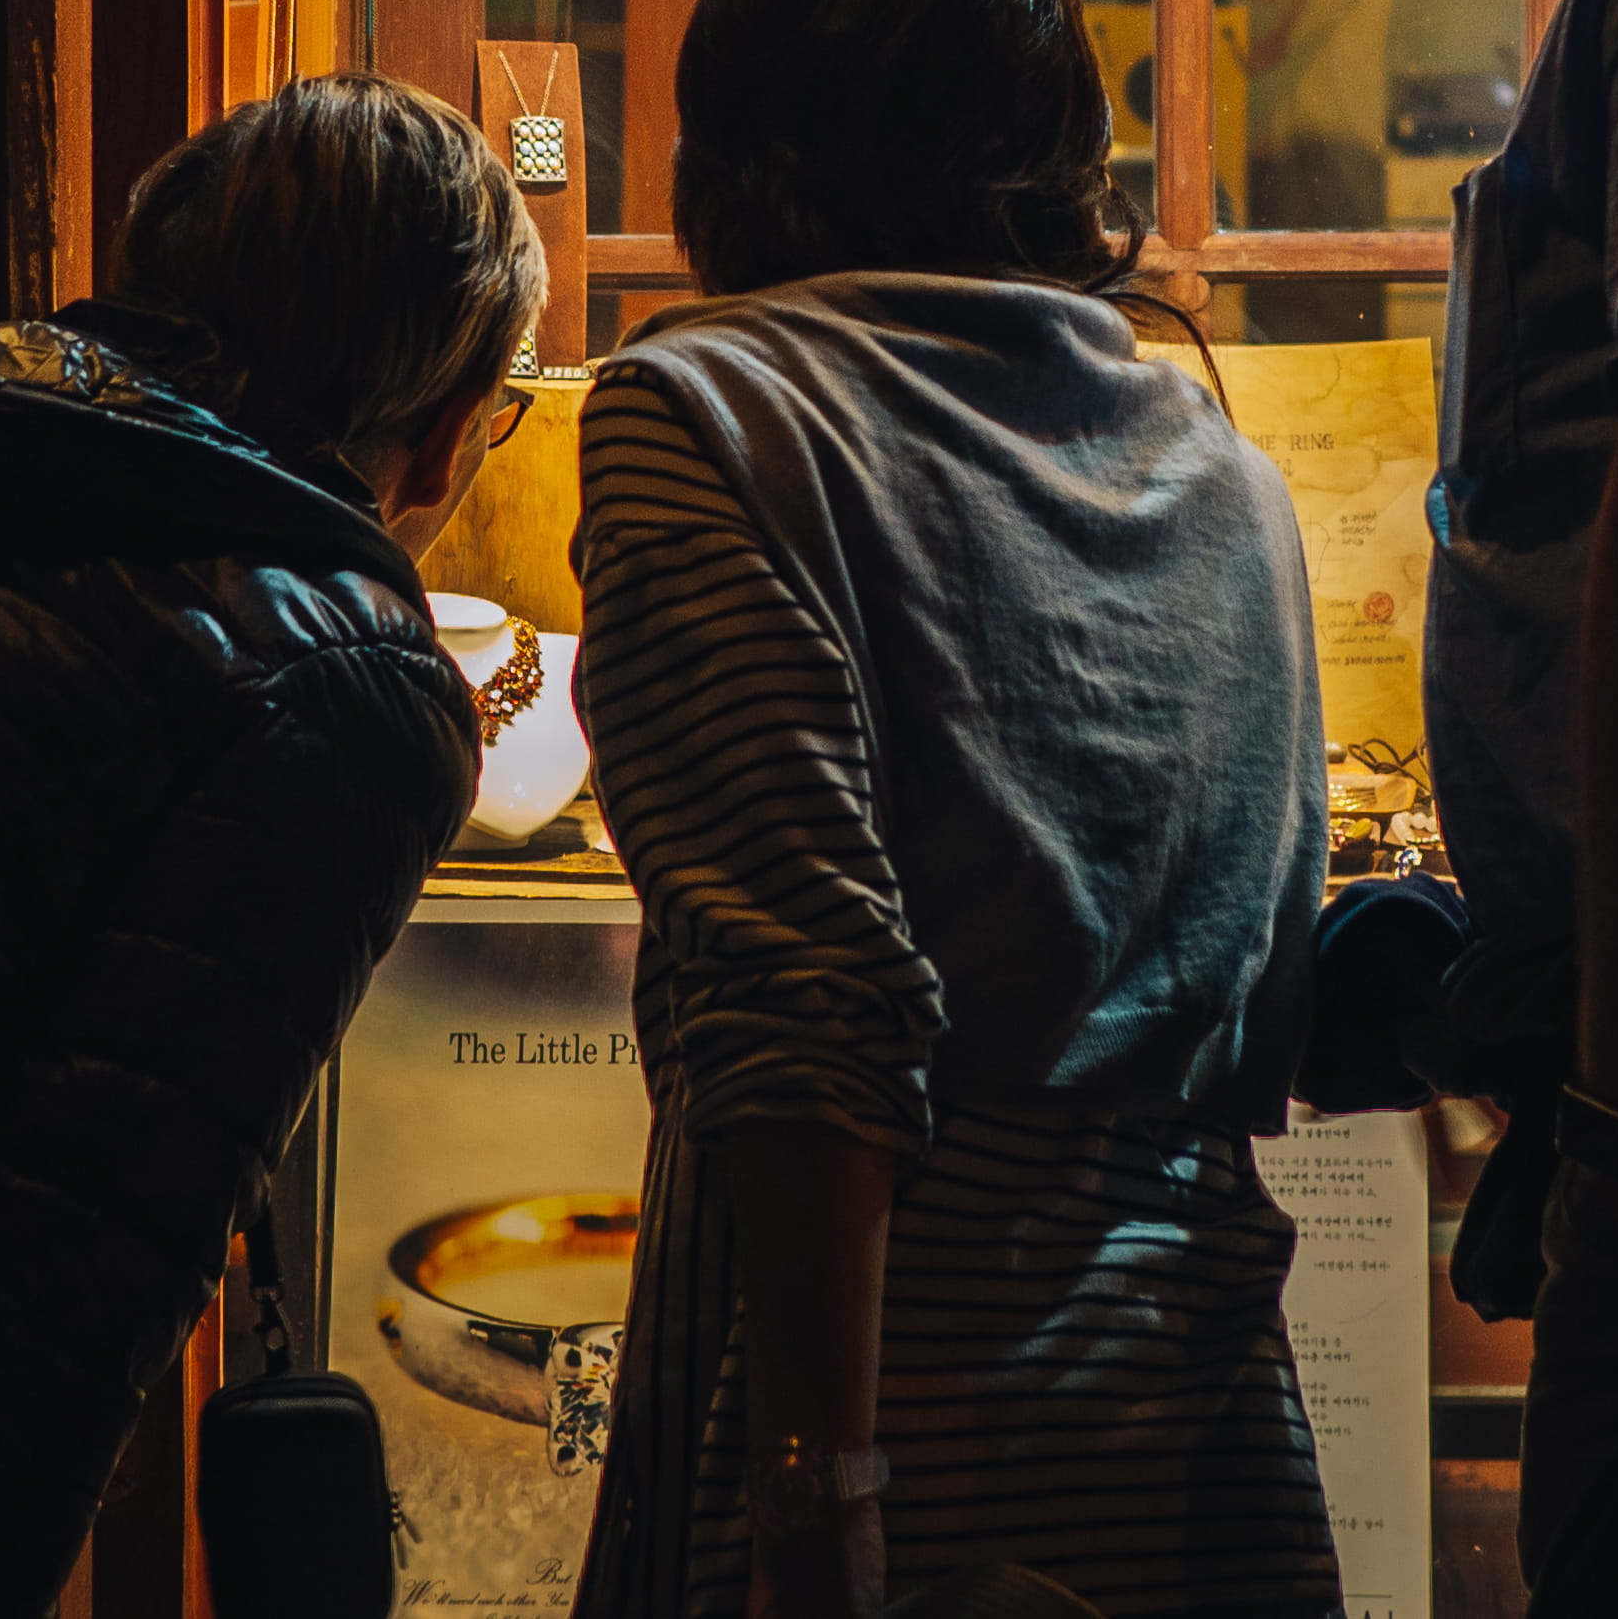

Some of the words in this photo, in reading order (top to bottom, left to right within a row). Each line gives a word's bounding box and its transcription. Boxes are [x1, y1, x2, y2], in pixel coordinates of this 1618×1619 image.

[1290, 433, 1334, 451] RING
[449, 1032, 506, 1064] The
[515, 1032, 598, 1064] Little
[608, 1032, 638, 1064] Pr
[526, 1558, 572, 1585] But
